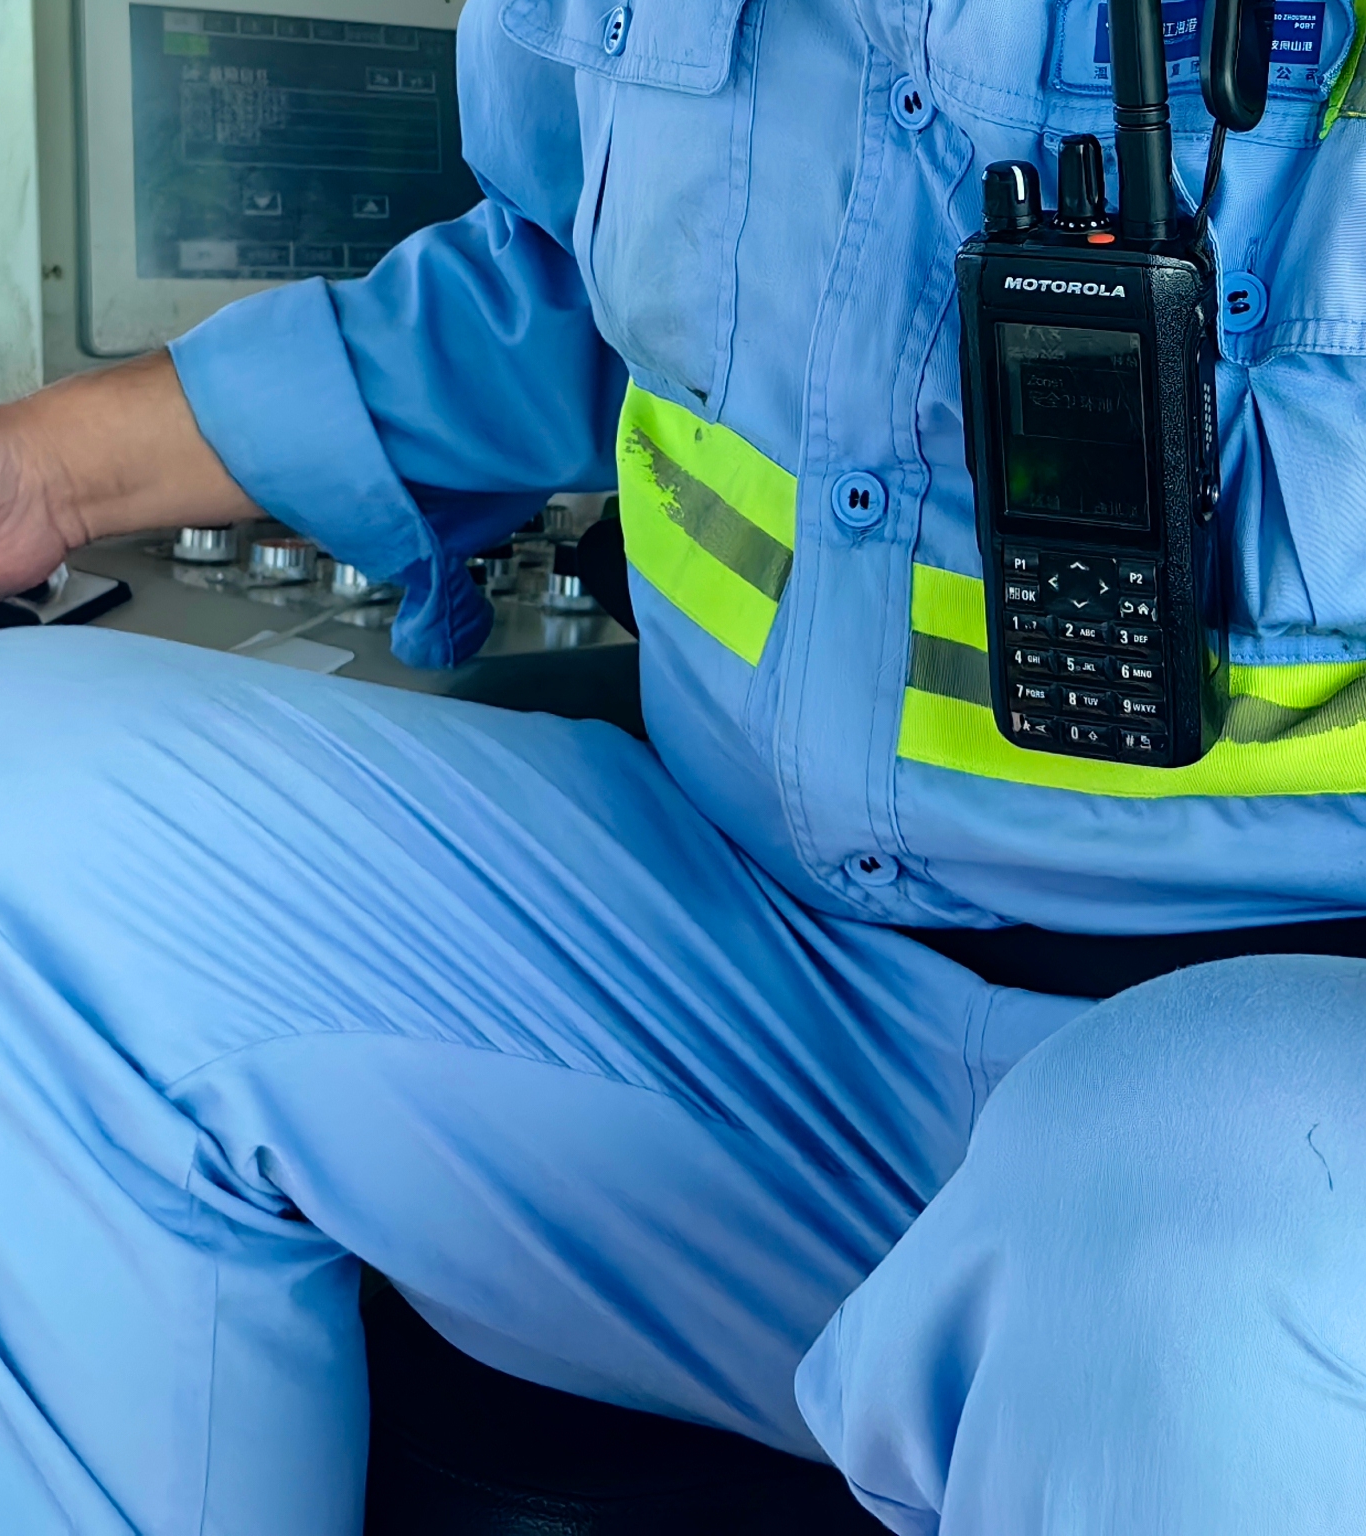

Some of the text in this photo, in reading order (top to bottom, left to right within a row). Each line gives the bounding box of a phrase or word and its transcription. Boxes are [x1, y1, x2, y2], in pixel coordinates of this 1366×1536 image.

[1004, 276, 1126, 298] MOTOROLA
[1014, 558, 1026, 570] P1
[1129, 572, 1143, 585] P2
[1021, 590, 1036, 602] OK
[1012, 616, 1019, 630] 1
[1065, 623, 1096, 638] 2 ABC
[1119, 630, 1148, 644] 3 DEF
[1014, 650, 1022, 664] 4
[1066, 657, 1075, 671] 5
[1121, 664, 1152, 679] 6 MNO
[1016, 684, 1024, 698] 7
[1068, 692, 1099, 706] 8 TUV
[1123, 699, 1132, 713] 9
[1070, 726, 1079, 740] 0
